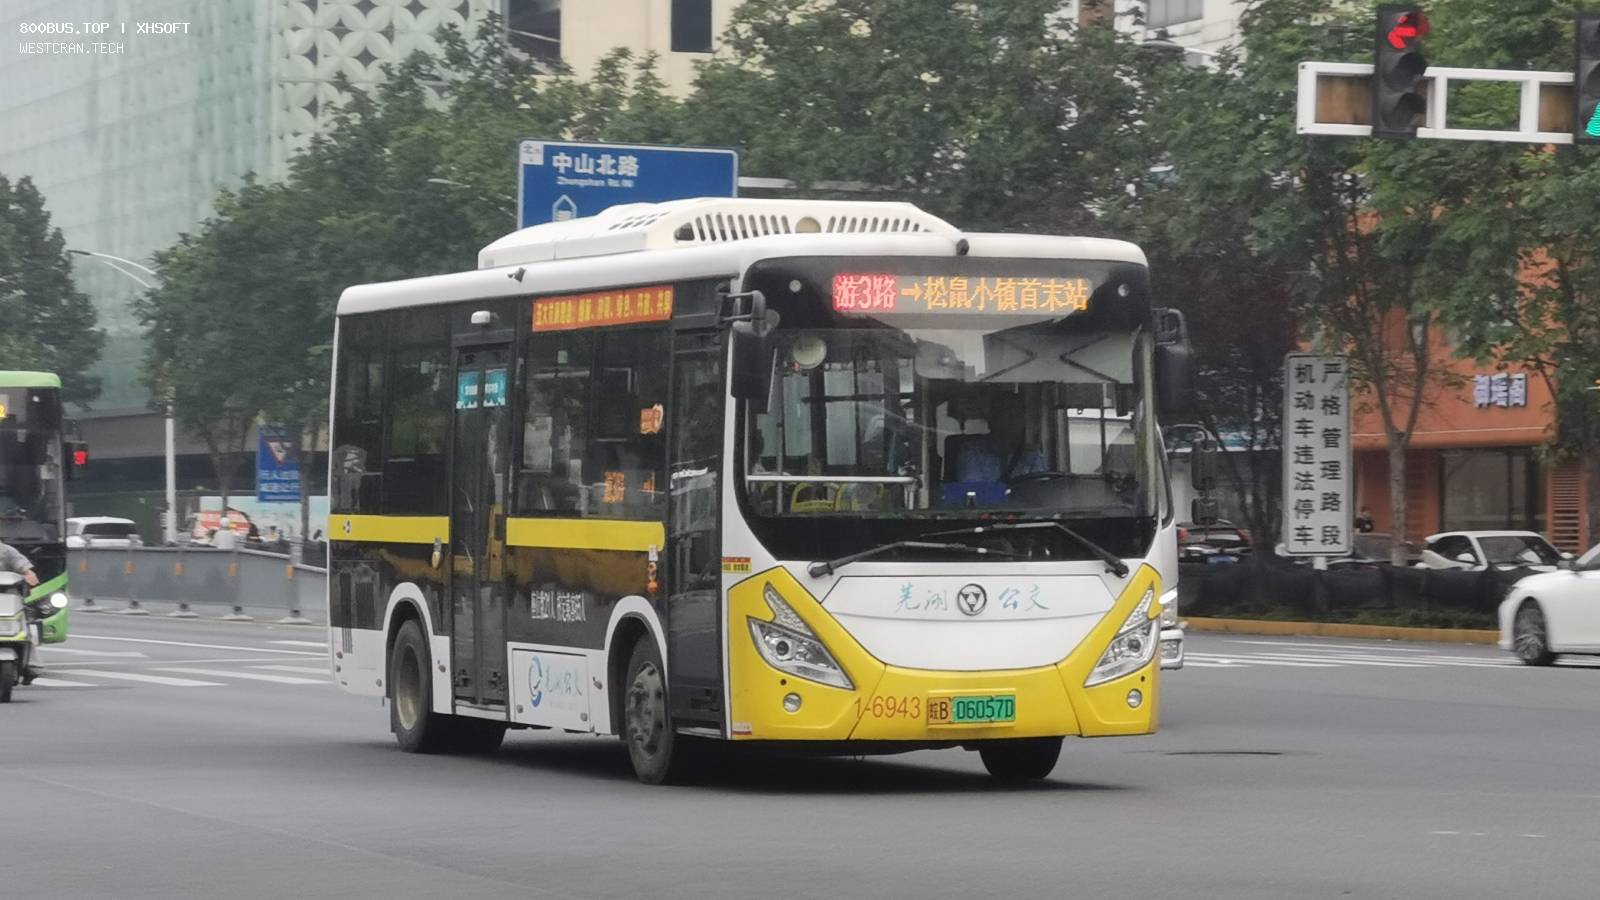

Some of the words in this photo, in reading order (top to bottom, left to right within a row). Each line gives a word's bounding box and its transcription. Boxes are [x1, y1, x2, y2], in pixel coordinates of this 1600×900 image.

[552, 152, 640, 177] 中山北路
[834, 275, 896, 311] 游3路
[923, 276, 1089, 311] 松鼠小镇首末站
[1293, 362, 1315, 546] 机动车违法停车
[1320, 362, 1342, 546] 严格管理路段
[998, 583, 1050, 612] 公交
[854, 695, 921, 719] 1-6943
